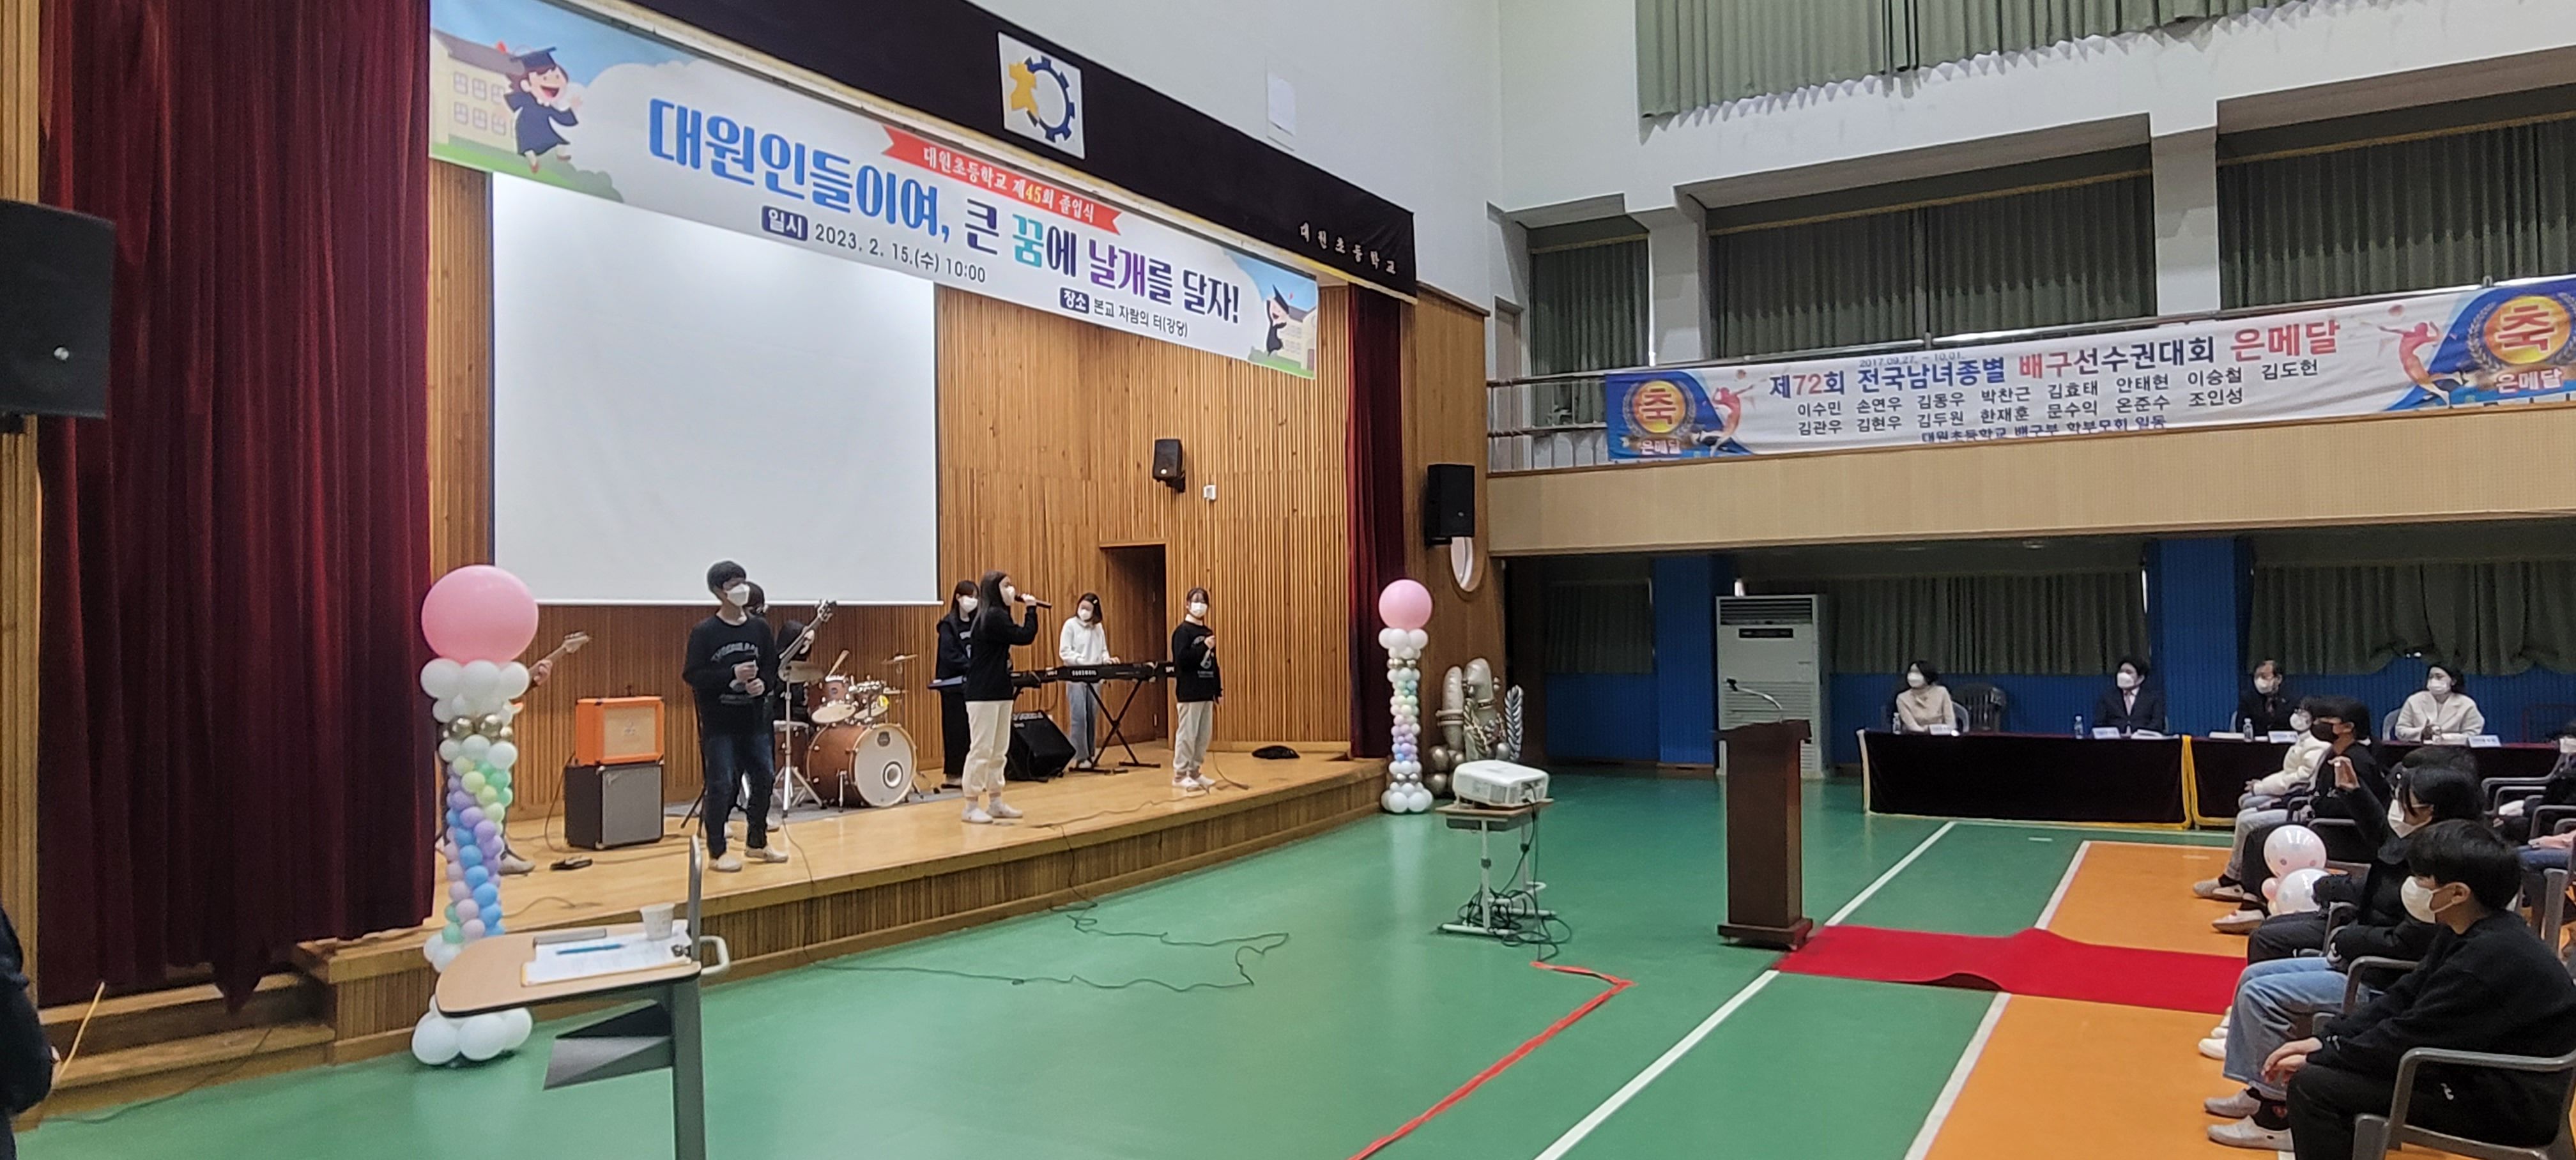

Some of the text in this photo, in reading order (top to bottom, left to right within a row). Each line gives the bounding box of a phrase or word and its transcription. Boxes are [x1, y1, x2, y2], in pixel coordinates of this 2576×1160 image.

[649, 98, 1239, 324] 대원인들이여, 큰 꿈에 날개를 달자!
[923, 146, 1094, 223] 대원초등학교 제45회 졸업식
[768, 208, 803, 238] 일시
[815, 223, 862, 252] 2023.
[869, 238, 884, 257] 2.
[946, 257, 985, 283] 10:00
[1063, 289, 1188, 338] 장소 본교 자람의 터(강당)
[2498, 305, 2555, 351] 축
[1769, 319, 2340, 399] 제72회 전국남녀종별 배구선수권대회 은메달
[2496, 368, 2563, 393] 은메달
[1641, 388, 1676, 425] 축
[1798, 359, 2318, 417] 이수민 손연우 김동우 박찬근 김효태 안태현 이승철 김도헌
[1798, 387, 2242, 436] 김관우 김현우 김두원 한재훈 문수익 온준수 조인성
